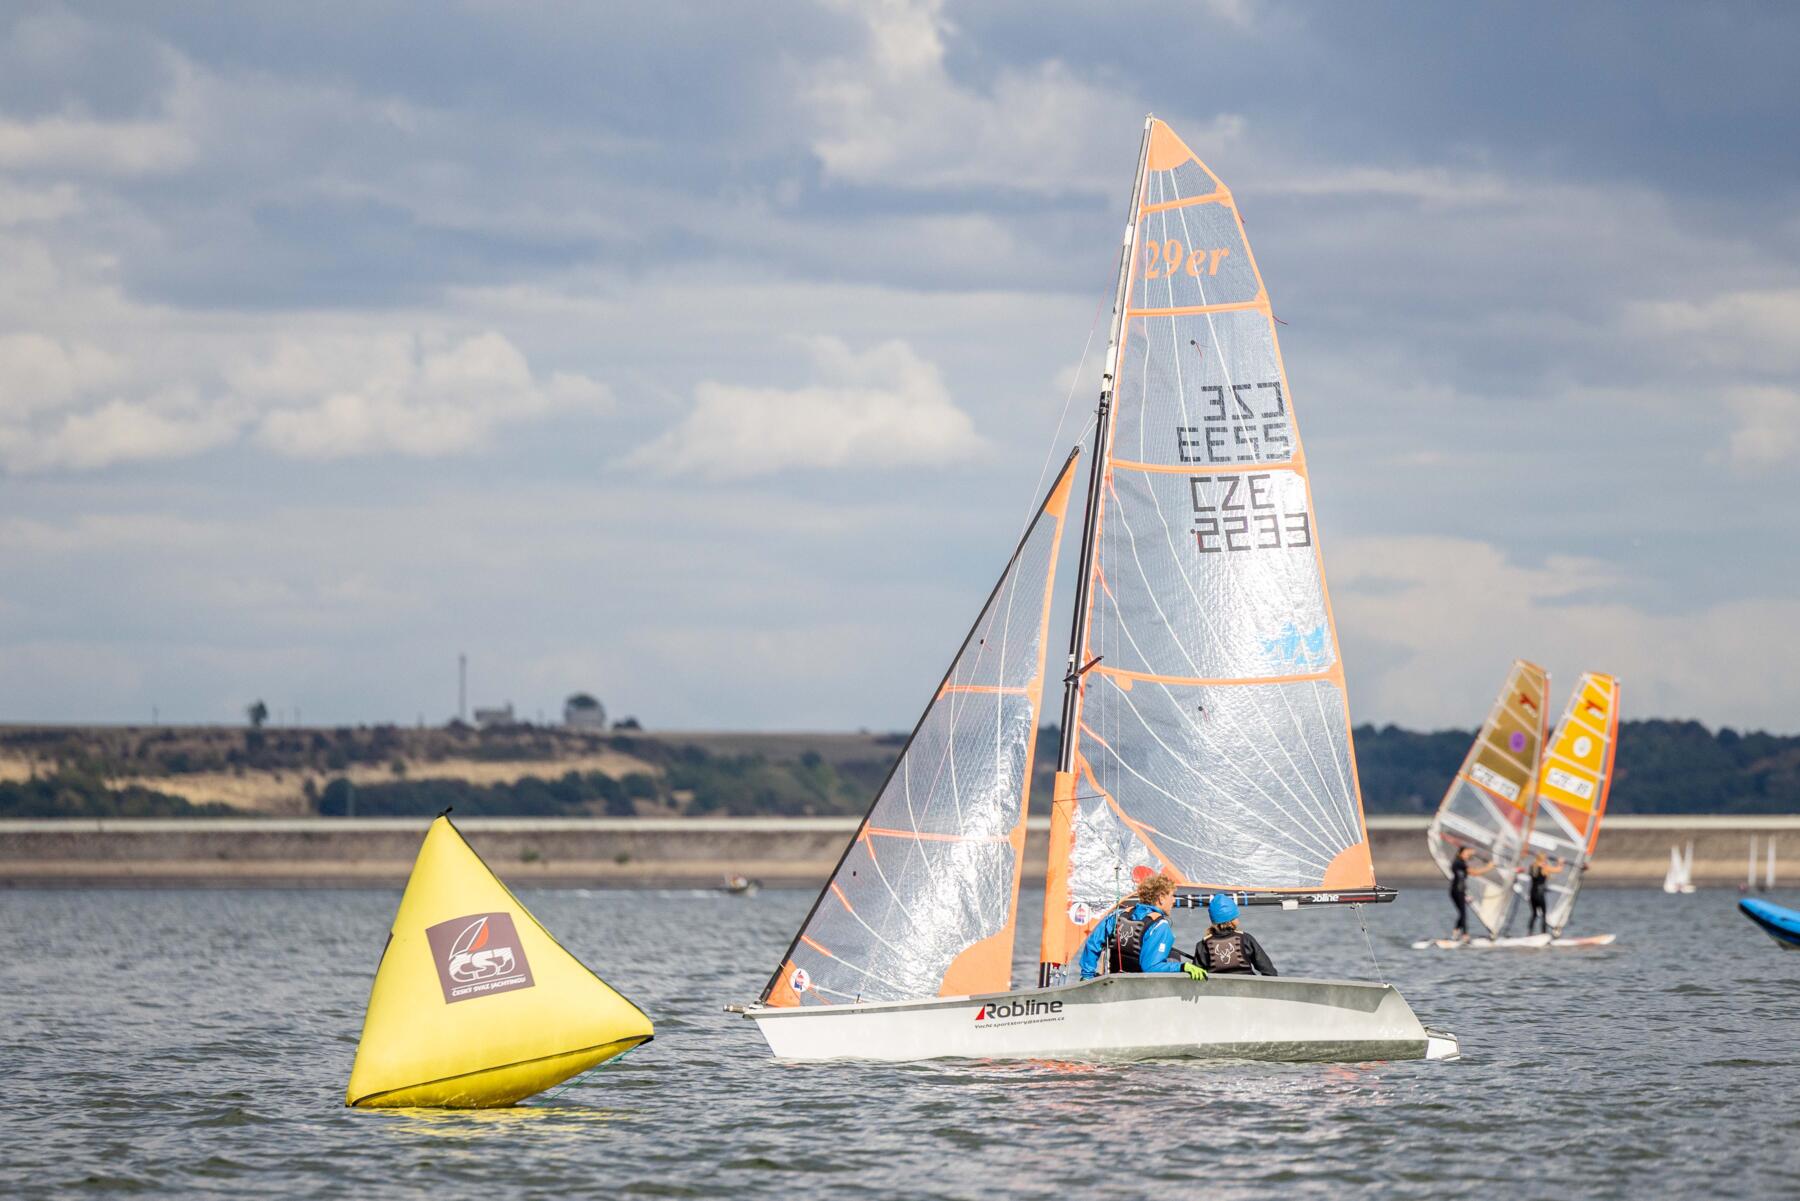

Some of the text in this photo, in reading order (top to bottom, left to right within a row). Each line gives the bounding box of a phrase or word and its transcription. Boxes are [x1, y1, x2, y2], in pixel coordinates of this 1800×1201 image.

[1145, 239, 1229, 279] 29er
[1190, 474, 1275, 512] CZE
[1195, 512, 1311, 553] 2233
[976, 999, 1063, 1020] Robline
